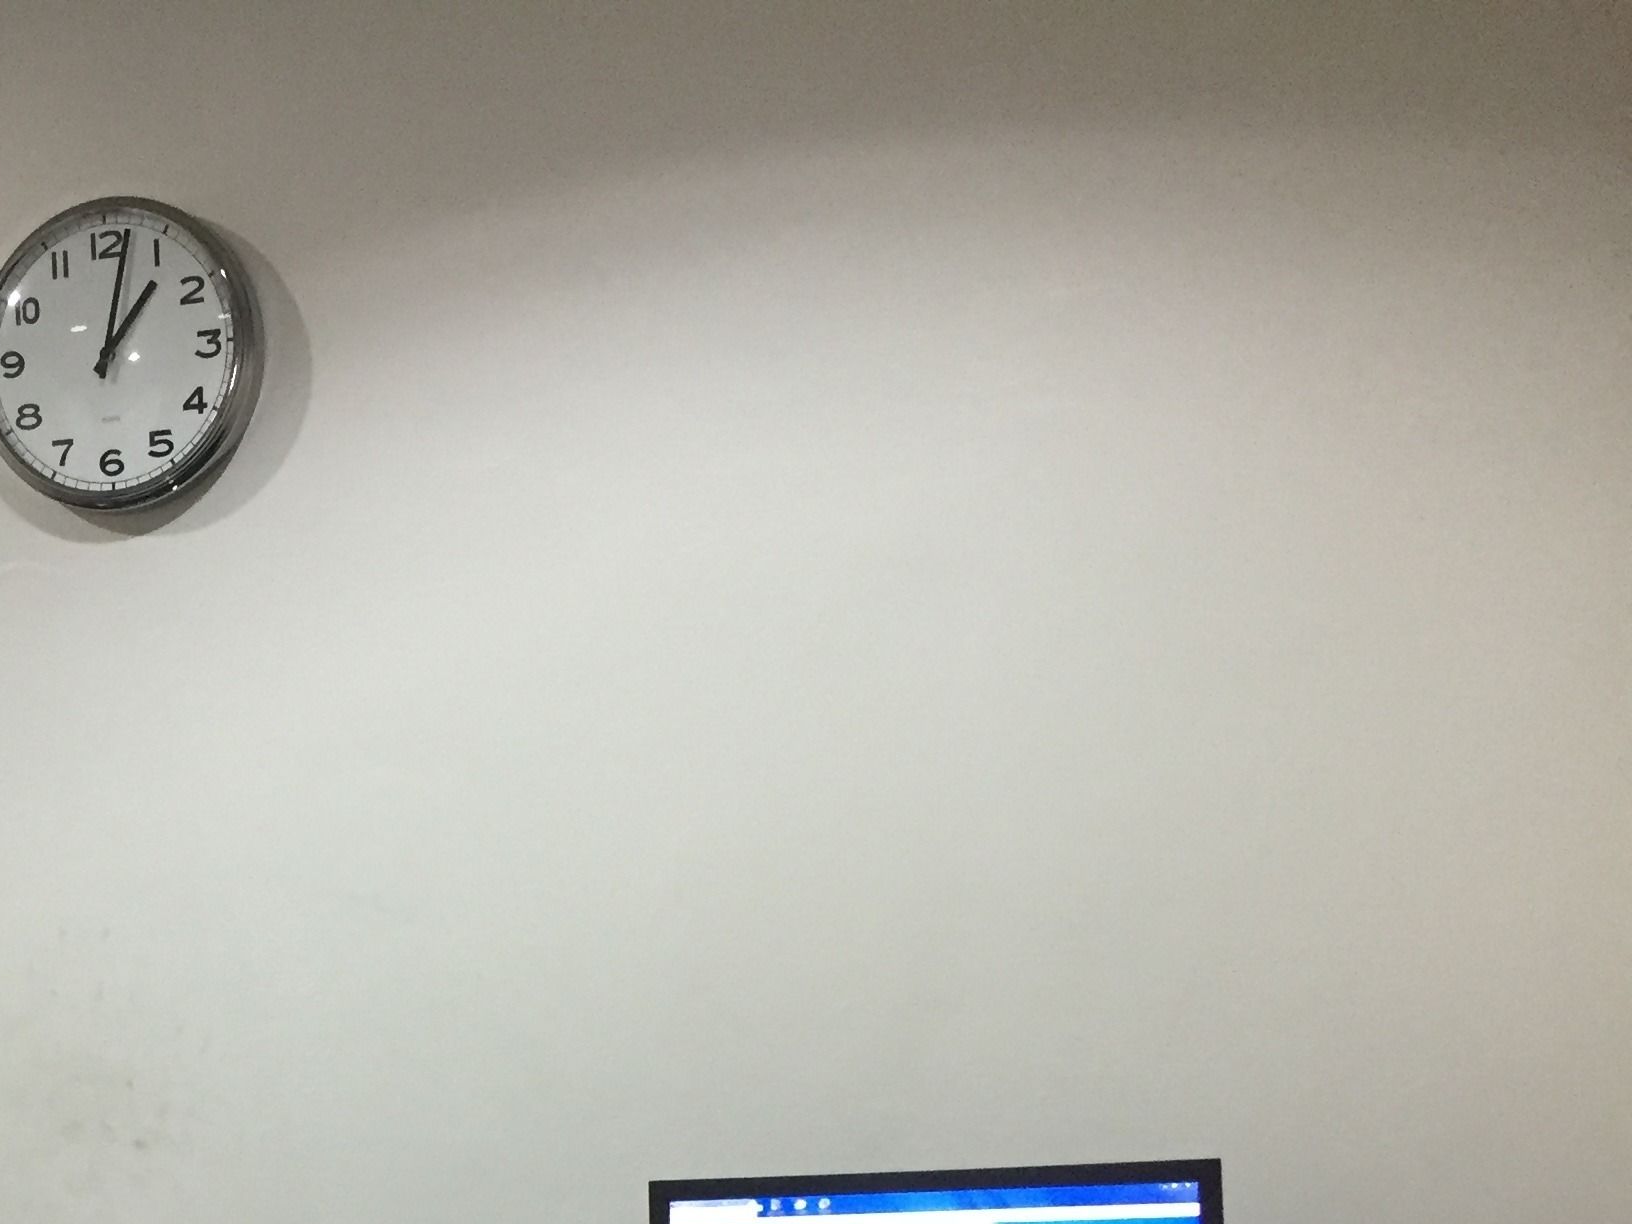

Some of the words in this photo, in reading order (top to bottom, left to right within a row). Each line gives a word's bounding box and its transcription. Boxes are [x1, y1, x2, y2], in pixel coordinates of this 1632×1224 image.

[90, 230, 124, 261] 12
[153, 238, 161, 267] 1
[51, 250, 69, 280] 11
[179, 276, 205, 305] 2
[14, 297, 40, 326] 10
[195, 328, 222, 359] 3
[0, 351, 25, 379] 9
[183, 386, 208, 415] 4
[16, 403, 43, 431] 8
[51, 438, 74, 467] 7
[148, 429, 175, 458] 5
[99, 448, 125, 477] 6
